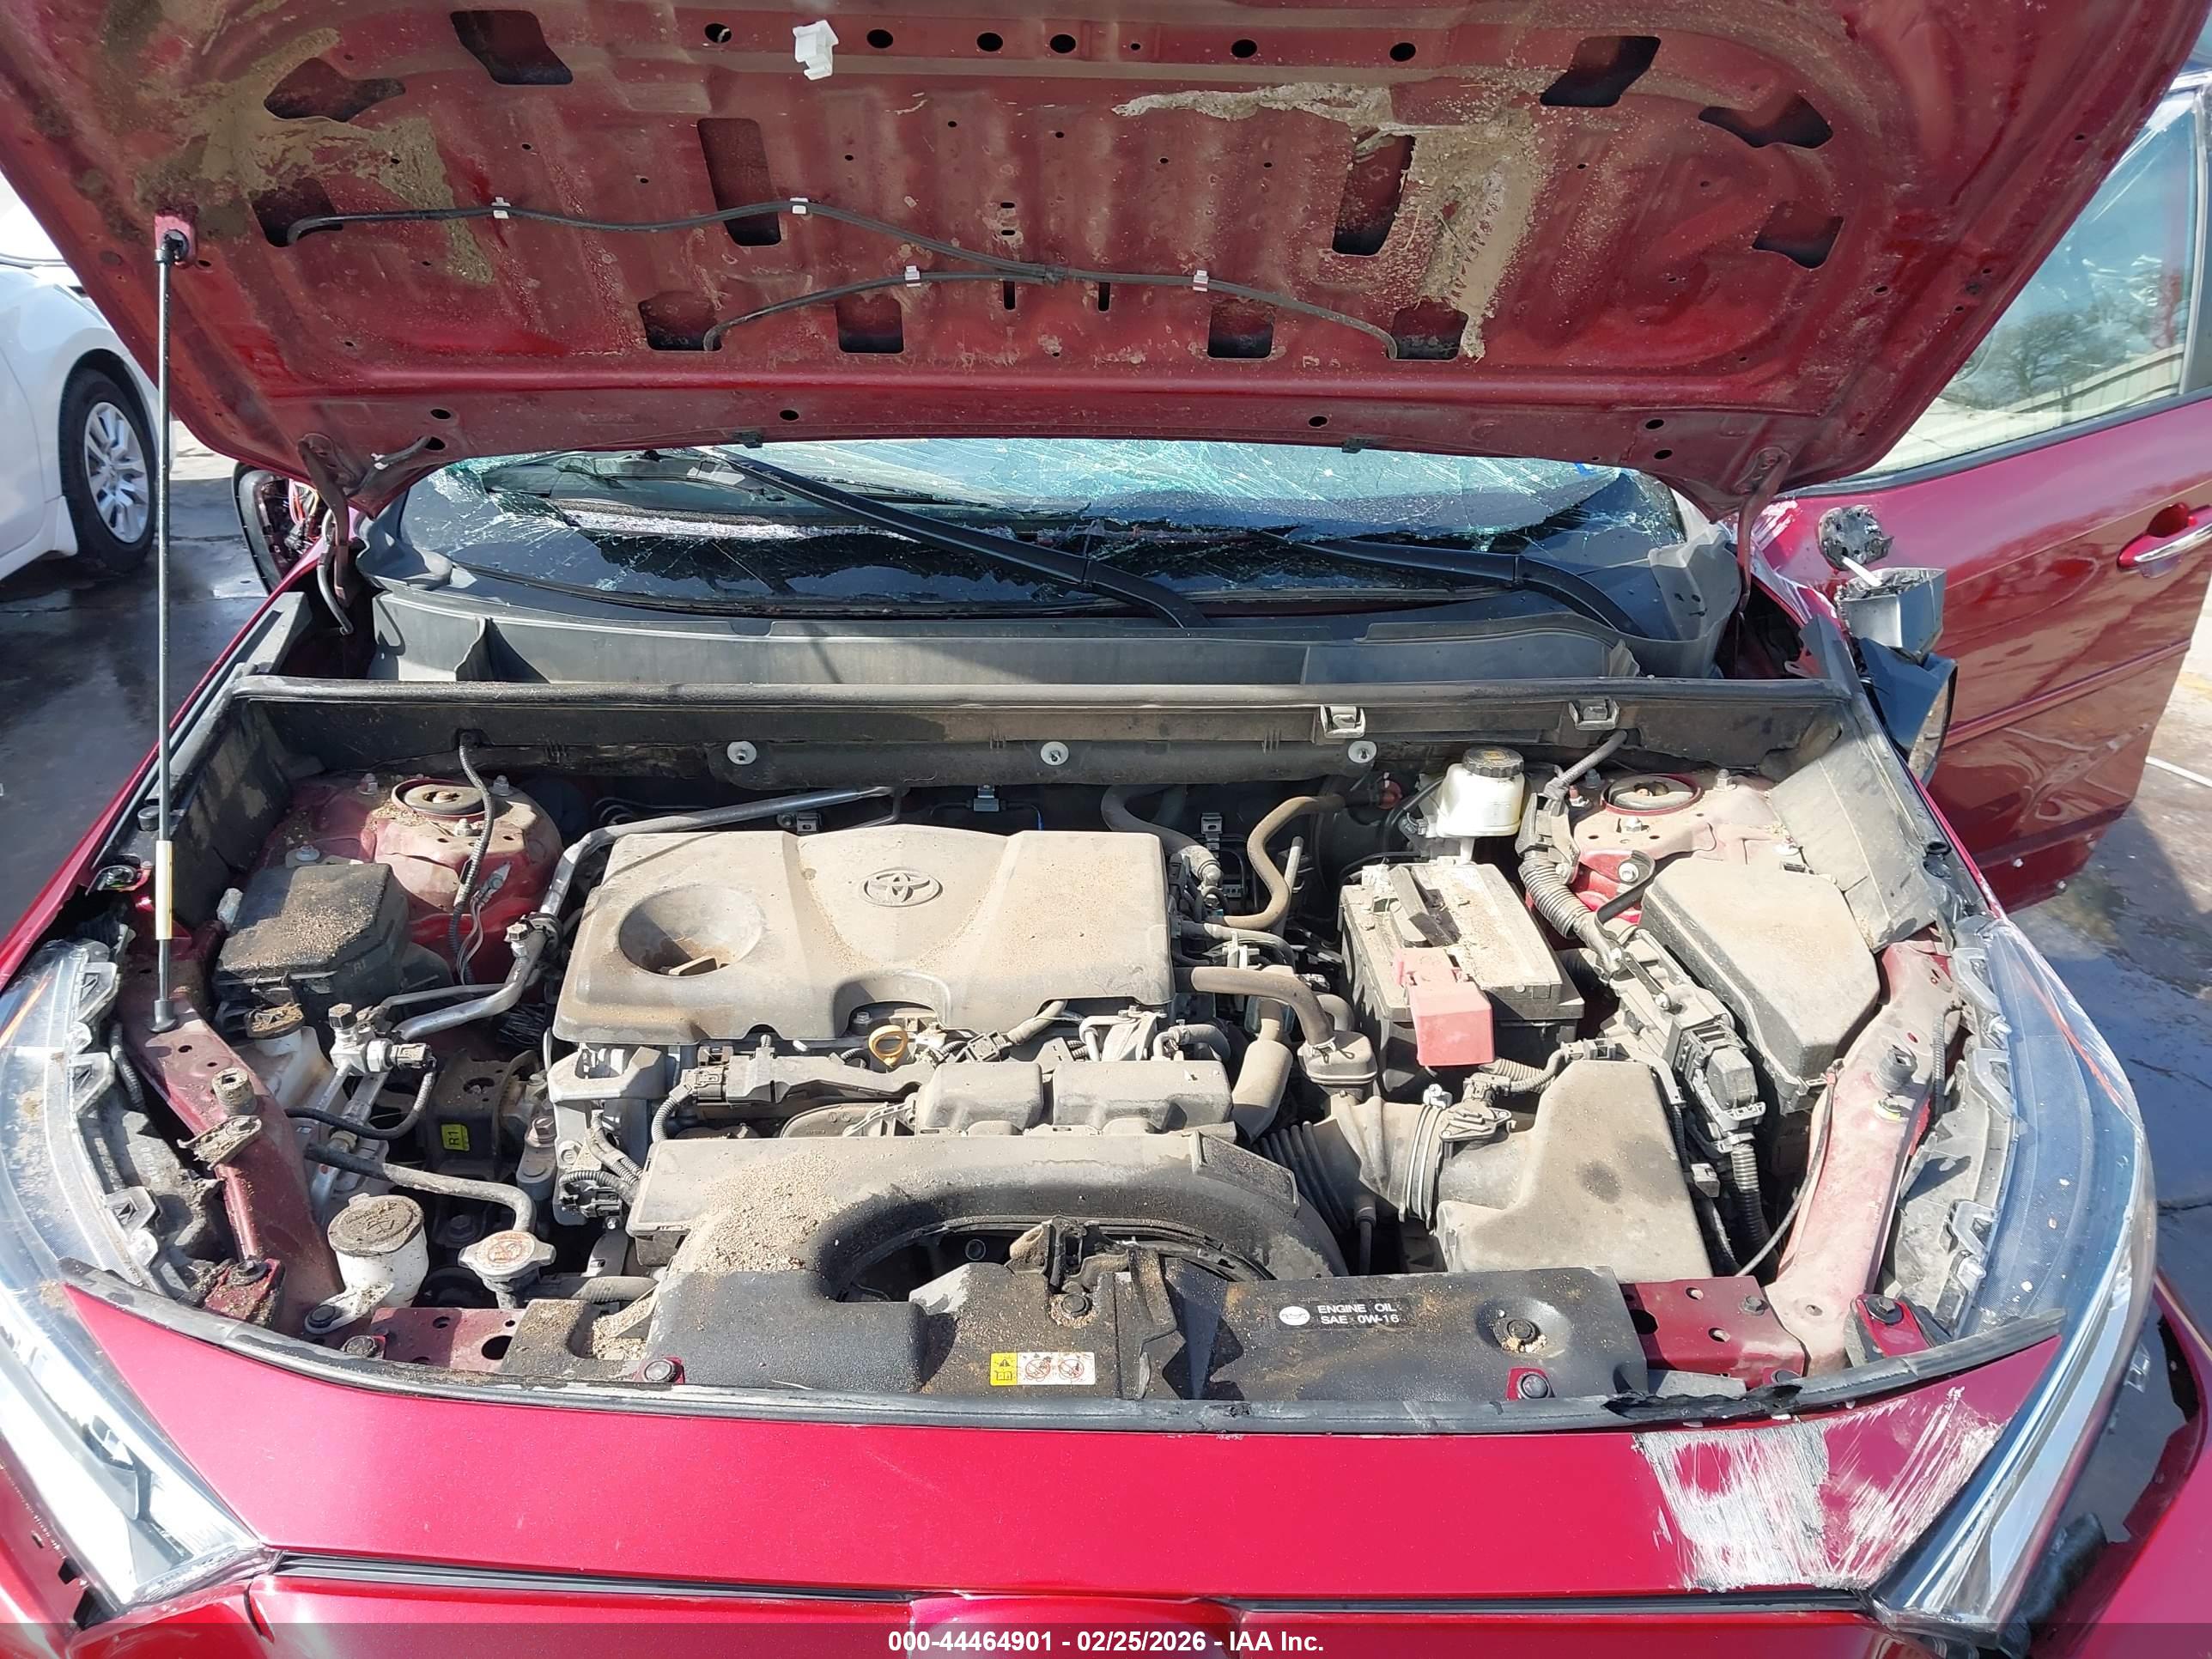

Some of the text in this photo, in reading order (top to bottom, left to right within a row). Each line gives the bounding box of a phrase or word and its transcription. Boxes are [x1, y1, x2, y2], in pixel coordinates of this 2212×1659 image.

[447, 1130, 460, 1146] R1
[1317, 1303, 1397, 1314] ENGINE OIL
[1321, 1314, 1400, 1325] SAE 0W-16
